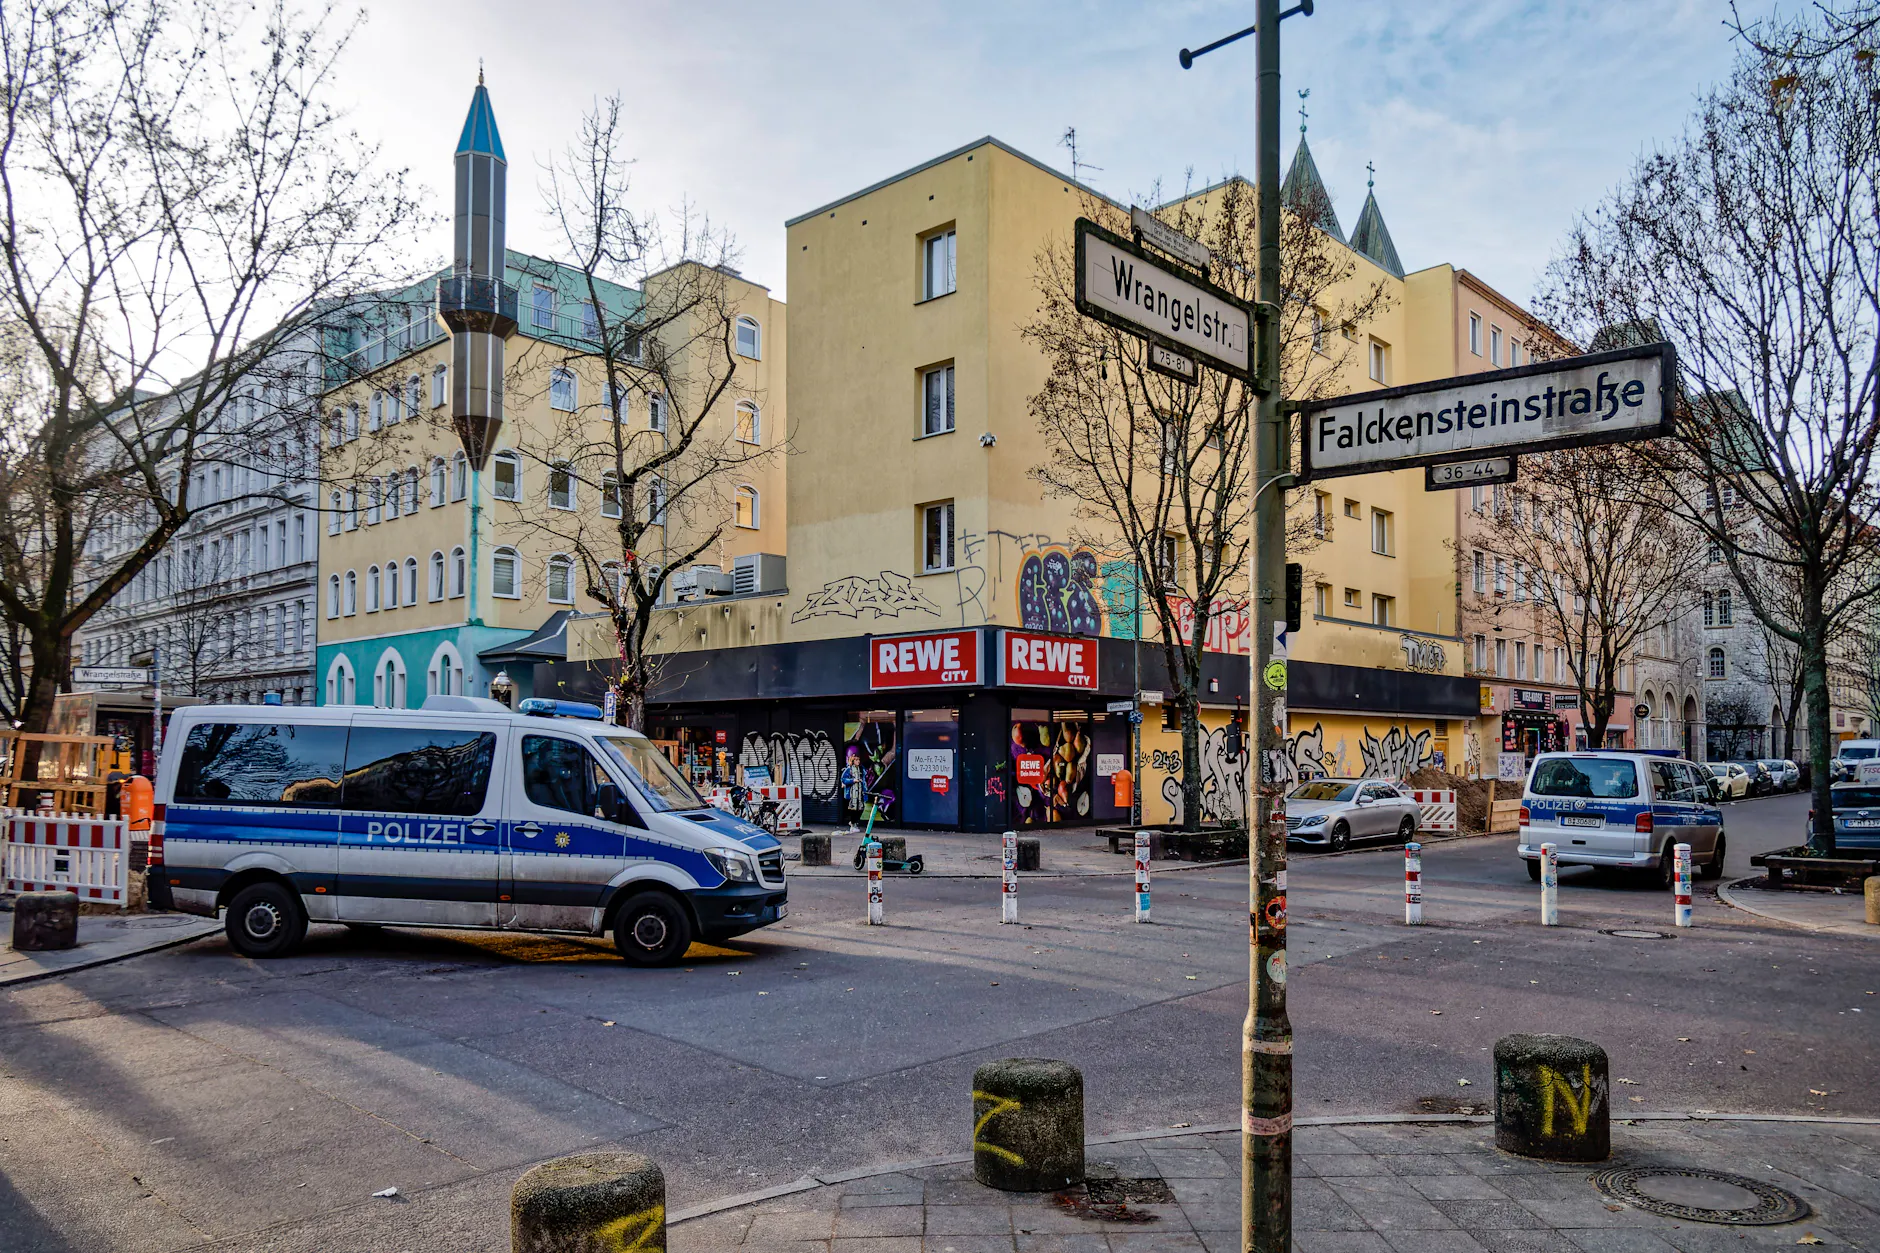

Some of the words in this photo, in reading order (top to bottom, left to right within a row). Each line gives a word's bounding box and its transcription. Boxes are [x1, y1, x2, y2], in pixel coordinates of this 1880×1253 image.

[1112, 255, 1232, 348] Wrangelstr.
[1159, 351, 1186, 372] 75-81
[1318, 371, 1645, 452] Falckensteinstraße
[1443, 462, 1494, 480] 36-44
[879, 638, 960, 673] REWE
[1011, 637, 1084, 673] REWE
[81, 669, 142, 680] Wrangelstraße
[941, 670, 968, 681] CITY
[1068, 674, 1090, 685] CITY
[1020, 760, 1040, 769] REWE
[1152, 749, 1182, 774] 243
[1530, 800, 1573, 811] POLIZEI
[367, 821, 465, 844] POLIZEI
